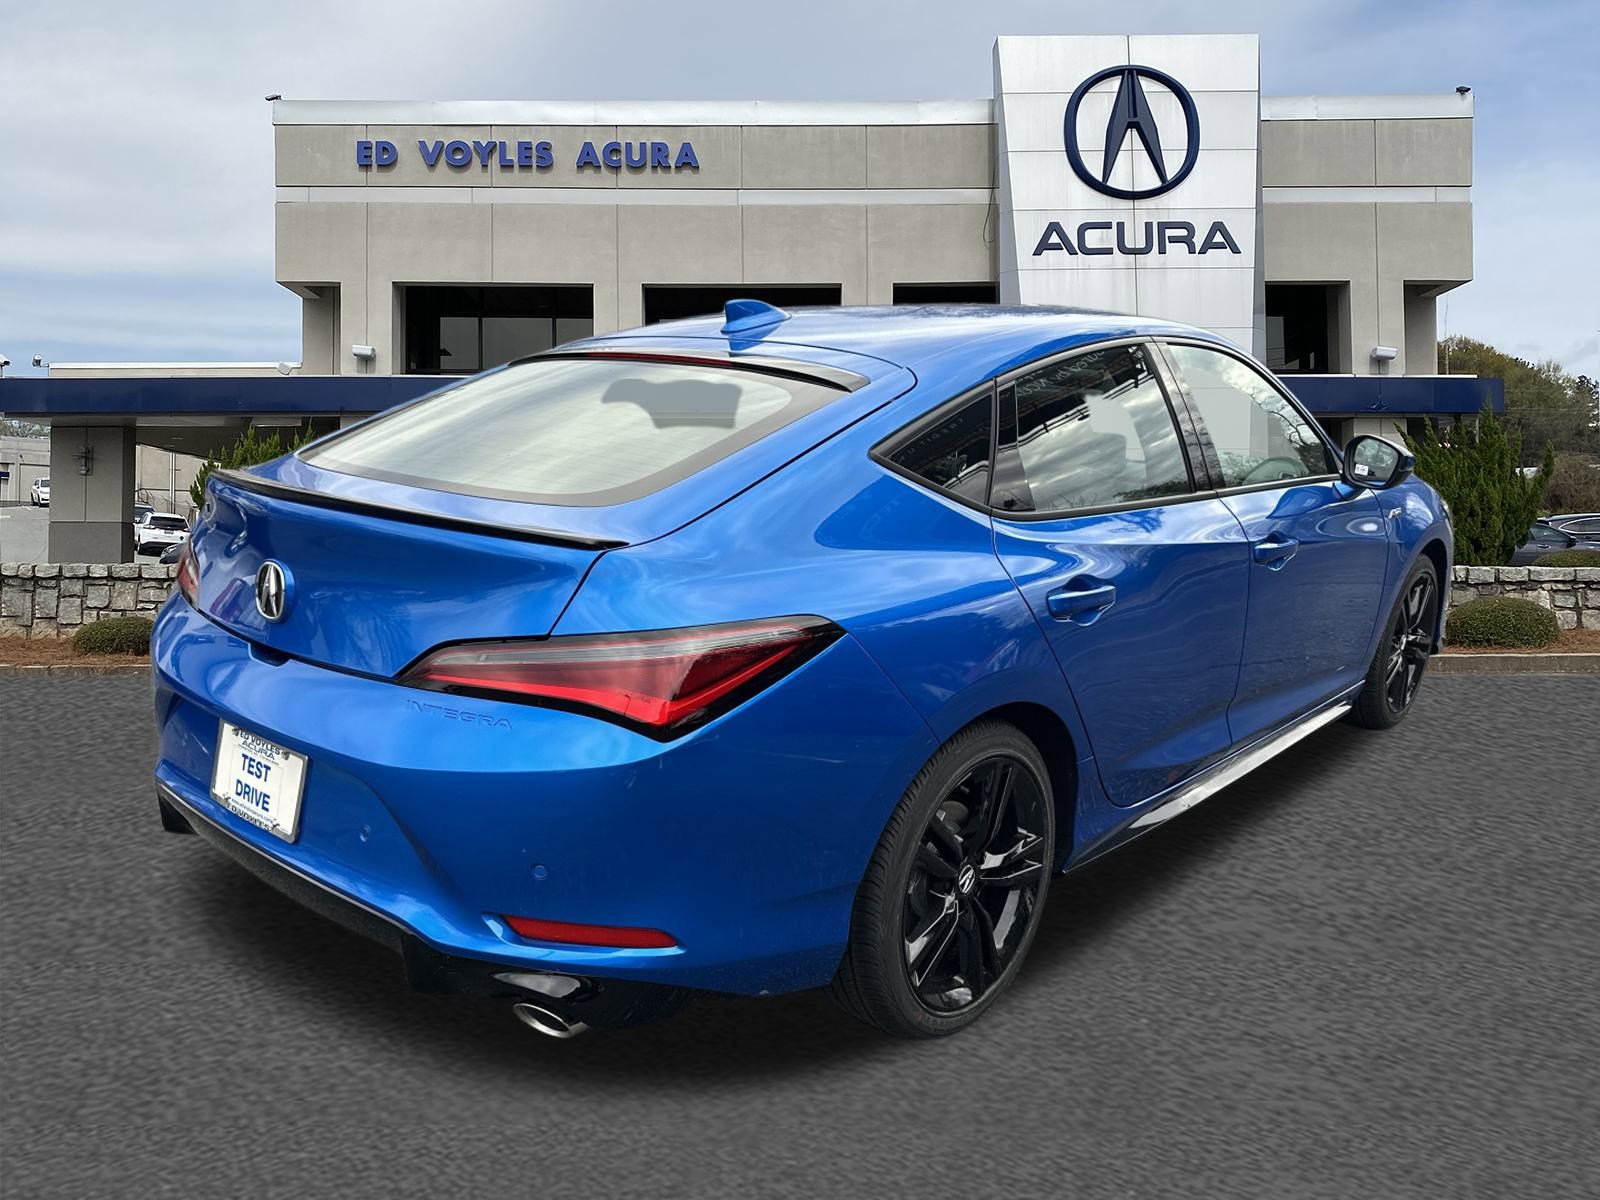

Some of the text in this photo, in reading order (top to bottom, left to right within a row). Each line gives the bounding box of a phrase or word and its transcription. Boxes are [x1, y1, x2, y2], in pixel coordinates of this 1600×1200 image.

[356, 140, 701, 169] ED VOYLES ACURA
[1032, 221, 1242, 256] ACURA
[404, 699, 513, 730] INTEGRA
[242, 740, 275, 760] ACURA
[250, 734, 281, 755] VOYLES
[242, 753, 272, 782] TEST
[235, 779, 271, 812] DRIVE
